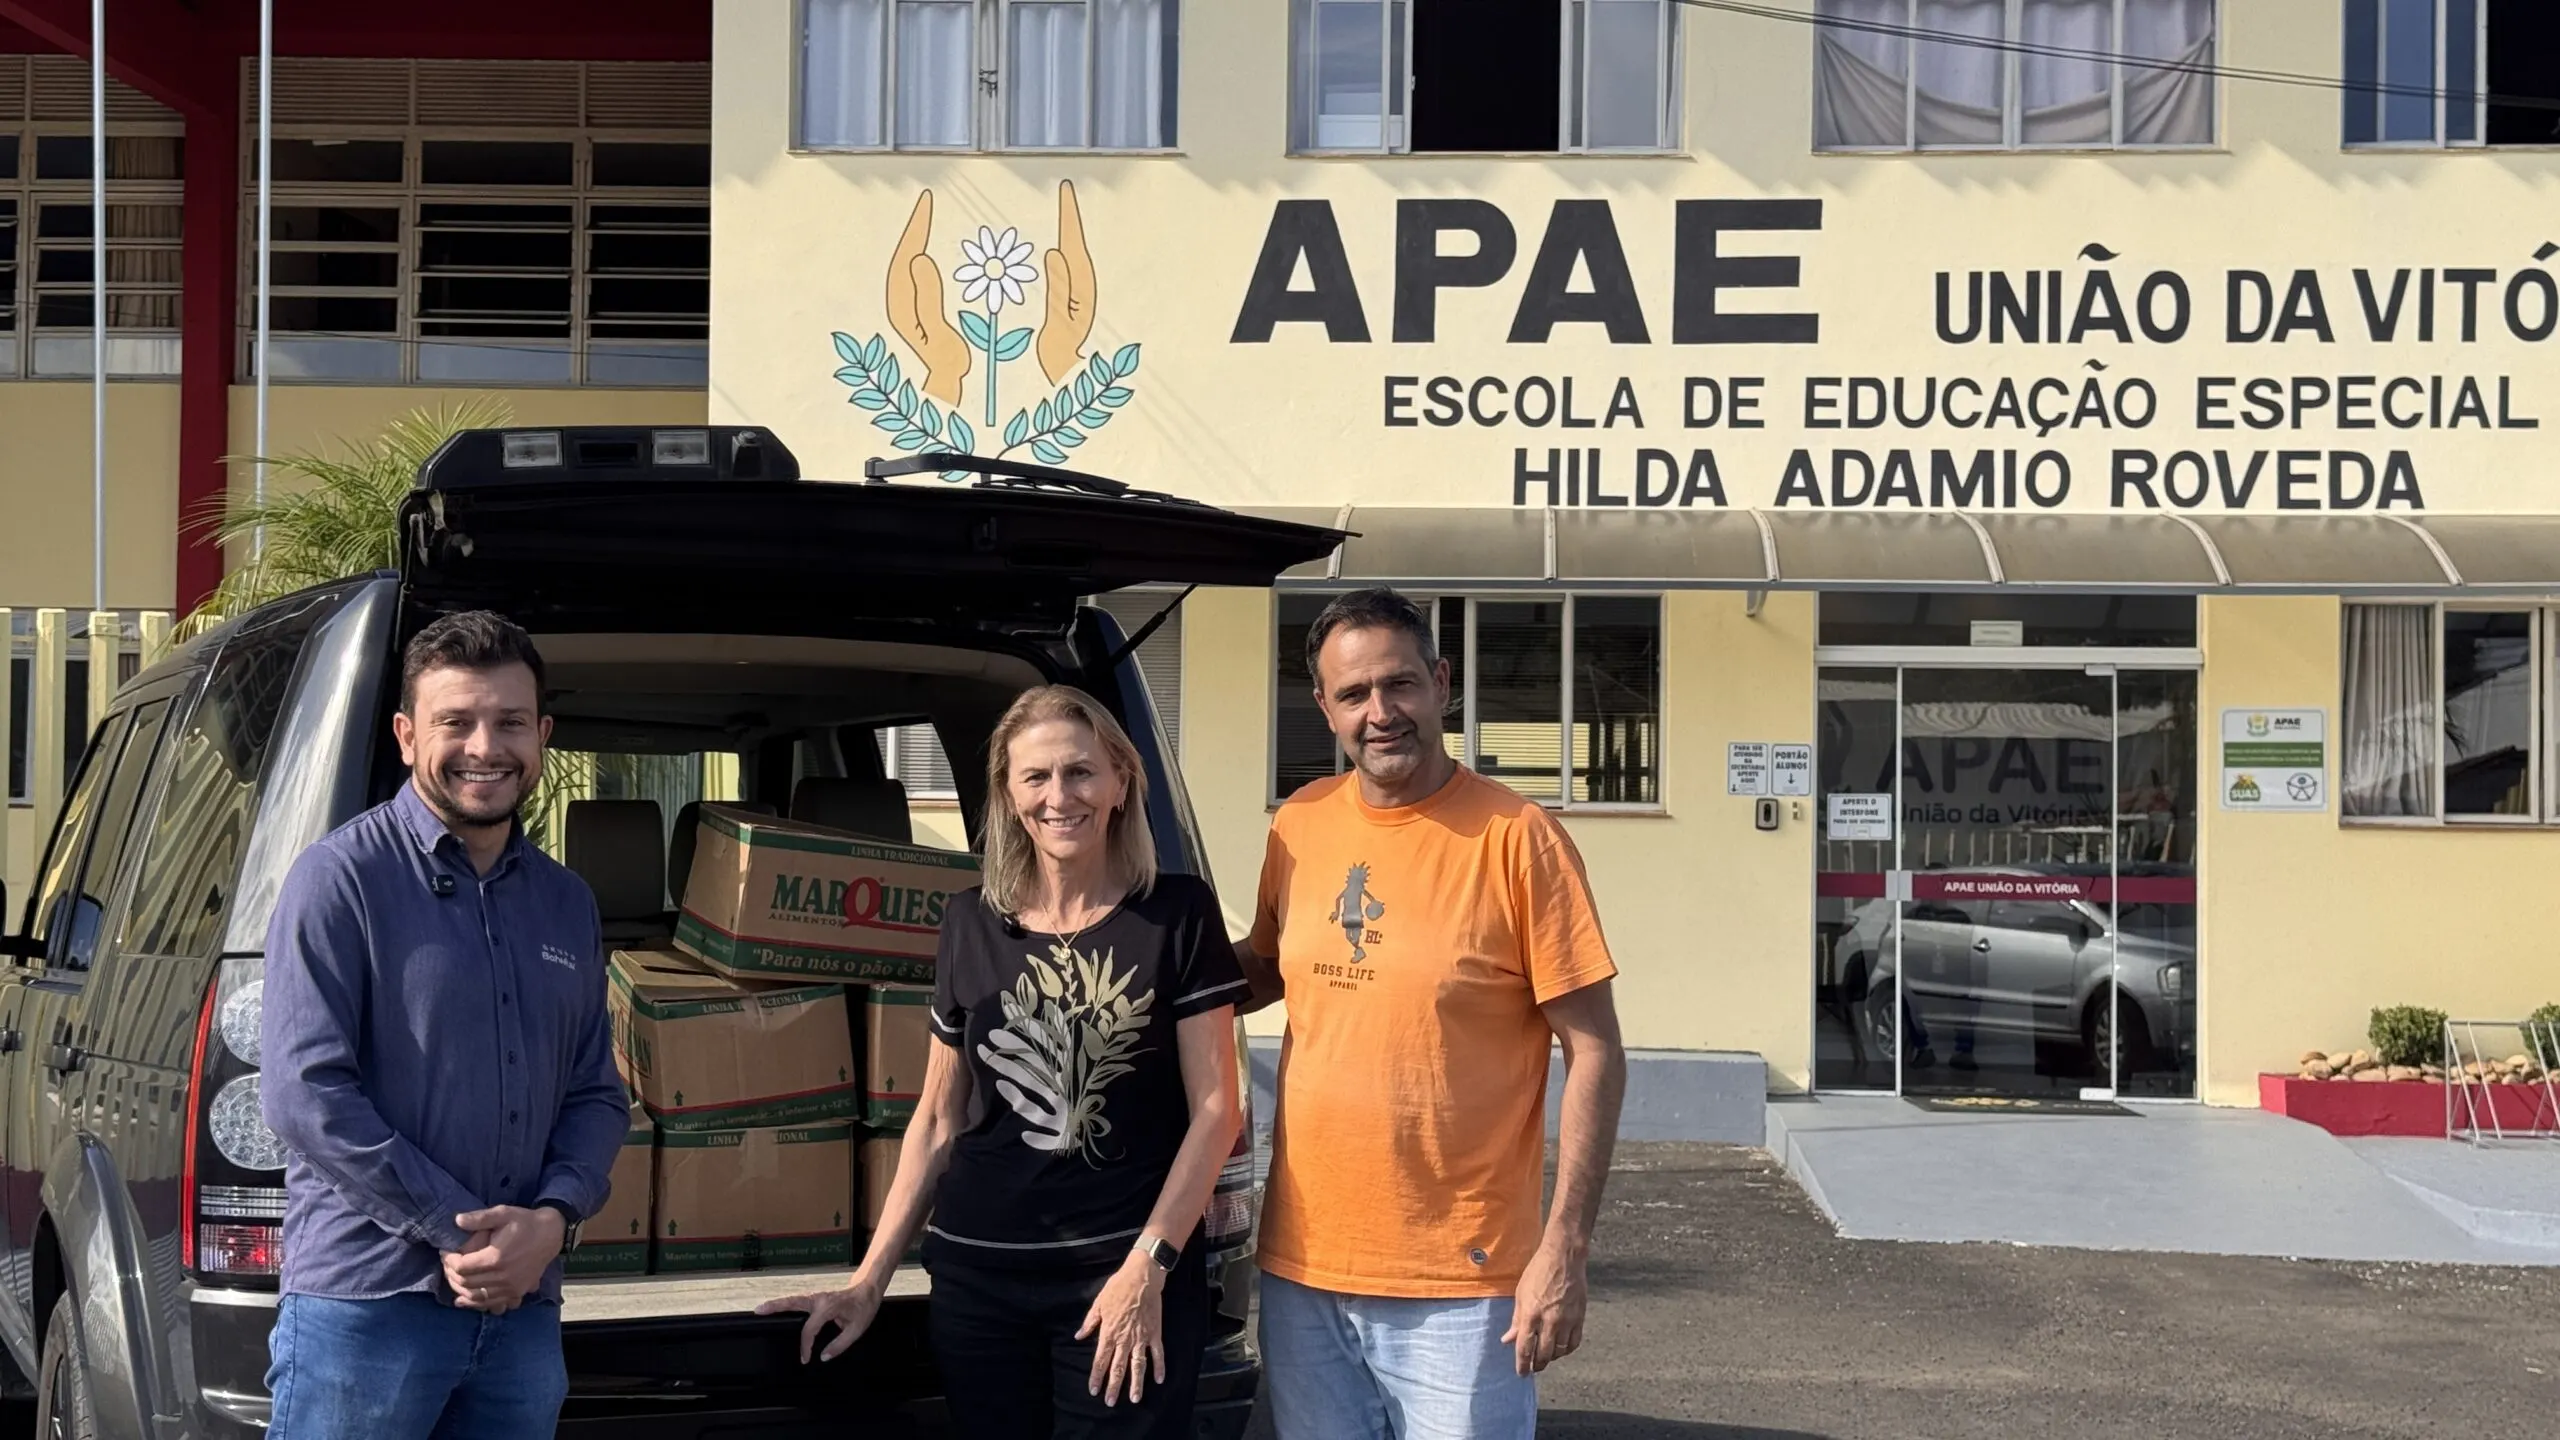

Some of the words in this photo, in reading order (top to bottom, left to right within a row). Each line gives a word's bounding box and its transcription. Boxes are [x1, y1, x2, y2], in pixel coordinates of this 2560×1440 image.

[1230, 198, 1823, 345] APAE
[1936, 243, 2191, 344] UNIÃO
[2227, 269, 2335, 343] DA
[2353, 241, 2560, 342] VITÓ
[1385, 376, 1644, 428] ESCOLA
[1685, 377, 1765, 429] DE
[1805, 359, 2157, 438] EDUCAÇÃO
[2198, 377, 2539, 430] ESPECIAL
[1514, 449, 1728, 507] HILDA
[1775, 450, 2071, 508] ADAMIO
[2112, 450, 2424, 510] ROVEDA
[2274, 717, 2301, 725] APAE
[1775, 749, 1808, 760] PORTÃO
[1775, 762, 1808, 770] ALUNOS
[1875, 736, 2105, 794] APAE
[1969, 804, 2000, 824] da
[851, 845, 881, 858] LINHA
[884, 849, 950, 867] TRADICIONAL
[1944, 882, 1975, 893] APAE
[1977, 881, 2013, 894] UNIÃO
[2015, 883, 2033, 894] DA
[2034, 882, 2081, 895] VITÓRIA
[770, 873, 958, 932] MARQUES
[807, 955, 840, 972] nós
[844, 961, 856, 972] o
[859, 959, 892, 976] pão
[1313, 963, 1343, 977] BOSS
[1347, 967, 1376, 980] LIFE
[1329, 980, 1358, 990] APPAREL
[702, 1001, 734, 1014] LINHA
[707, 1133, 740, 1146] LINHA
